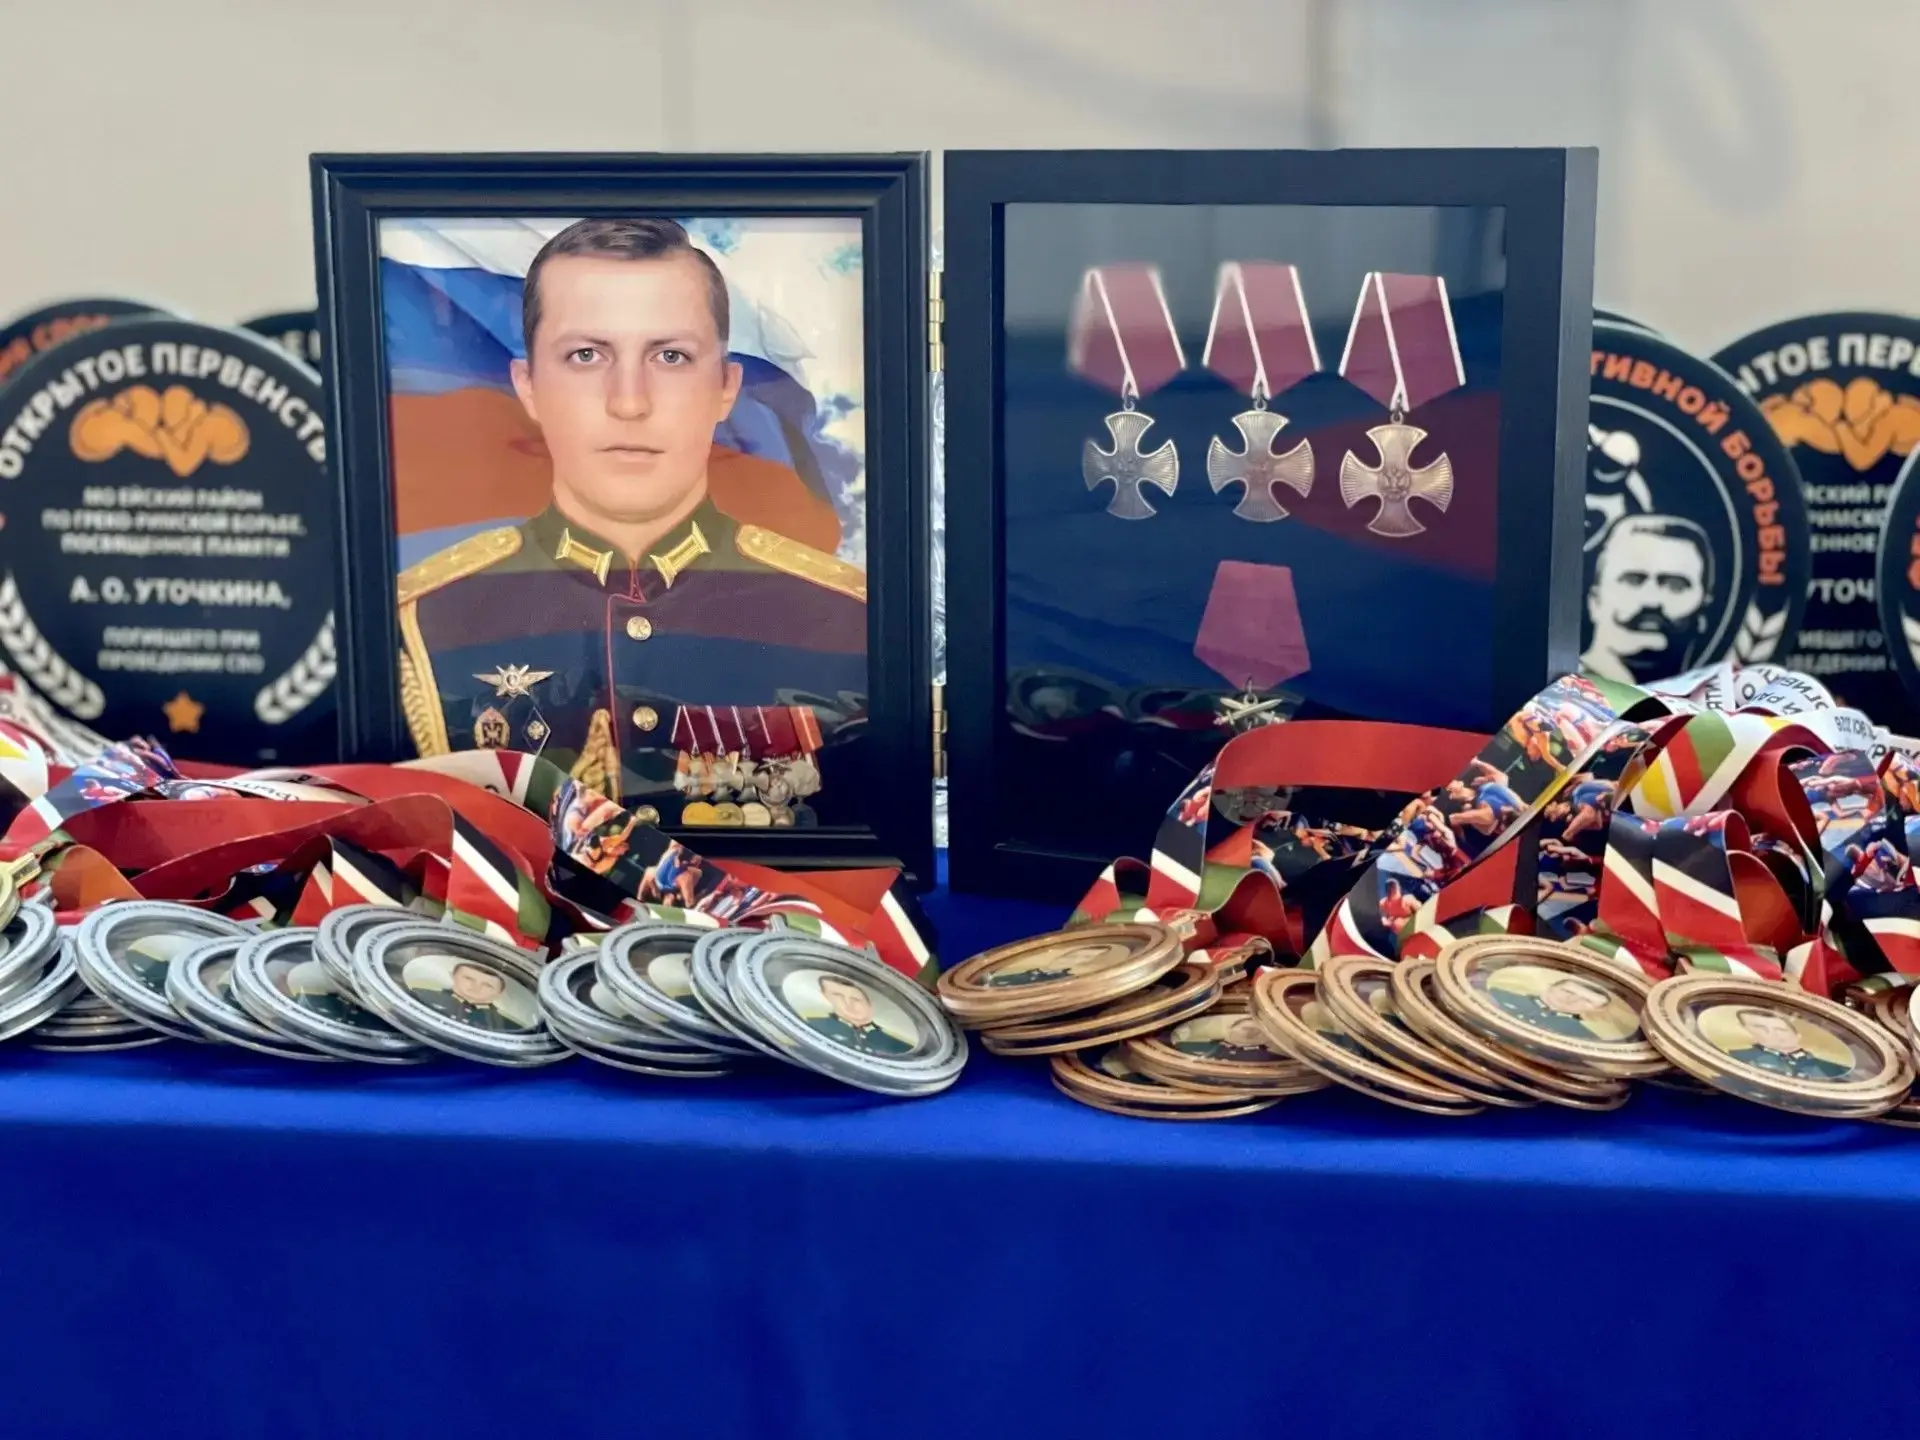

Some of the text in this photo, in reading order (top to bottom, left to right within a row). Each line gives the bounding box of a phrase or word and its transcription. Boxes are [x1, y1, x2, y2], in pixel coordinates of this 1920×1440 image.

[0, 343, 147, 480] ОТКРЫТОЕ
[1720, 429, 1786, 585] БОРЬБЫ
[70, 575, 292, 610] А. О. УТОЧКИНА,
